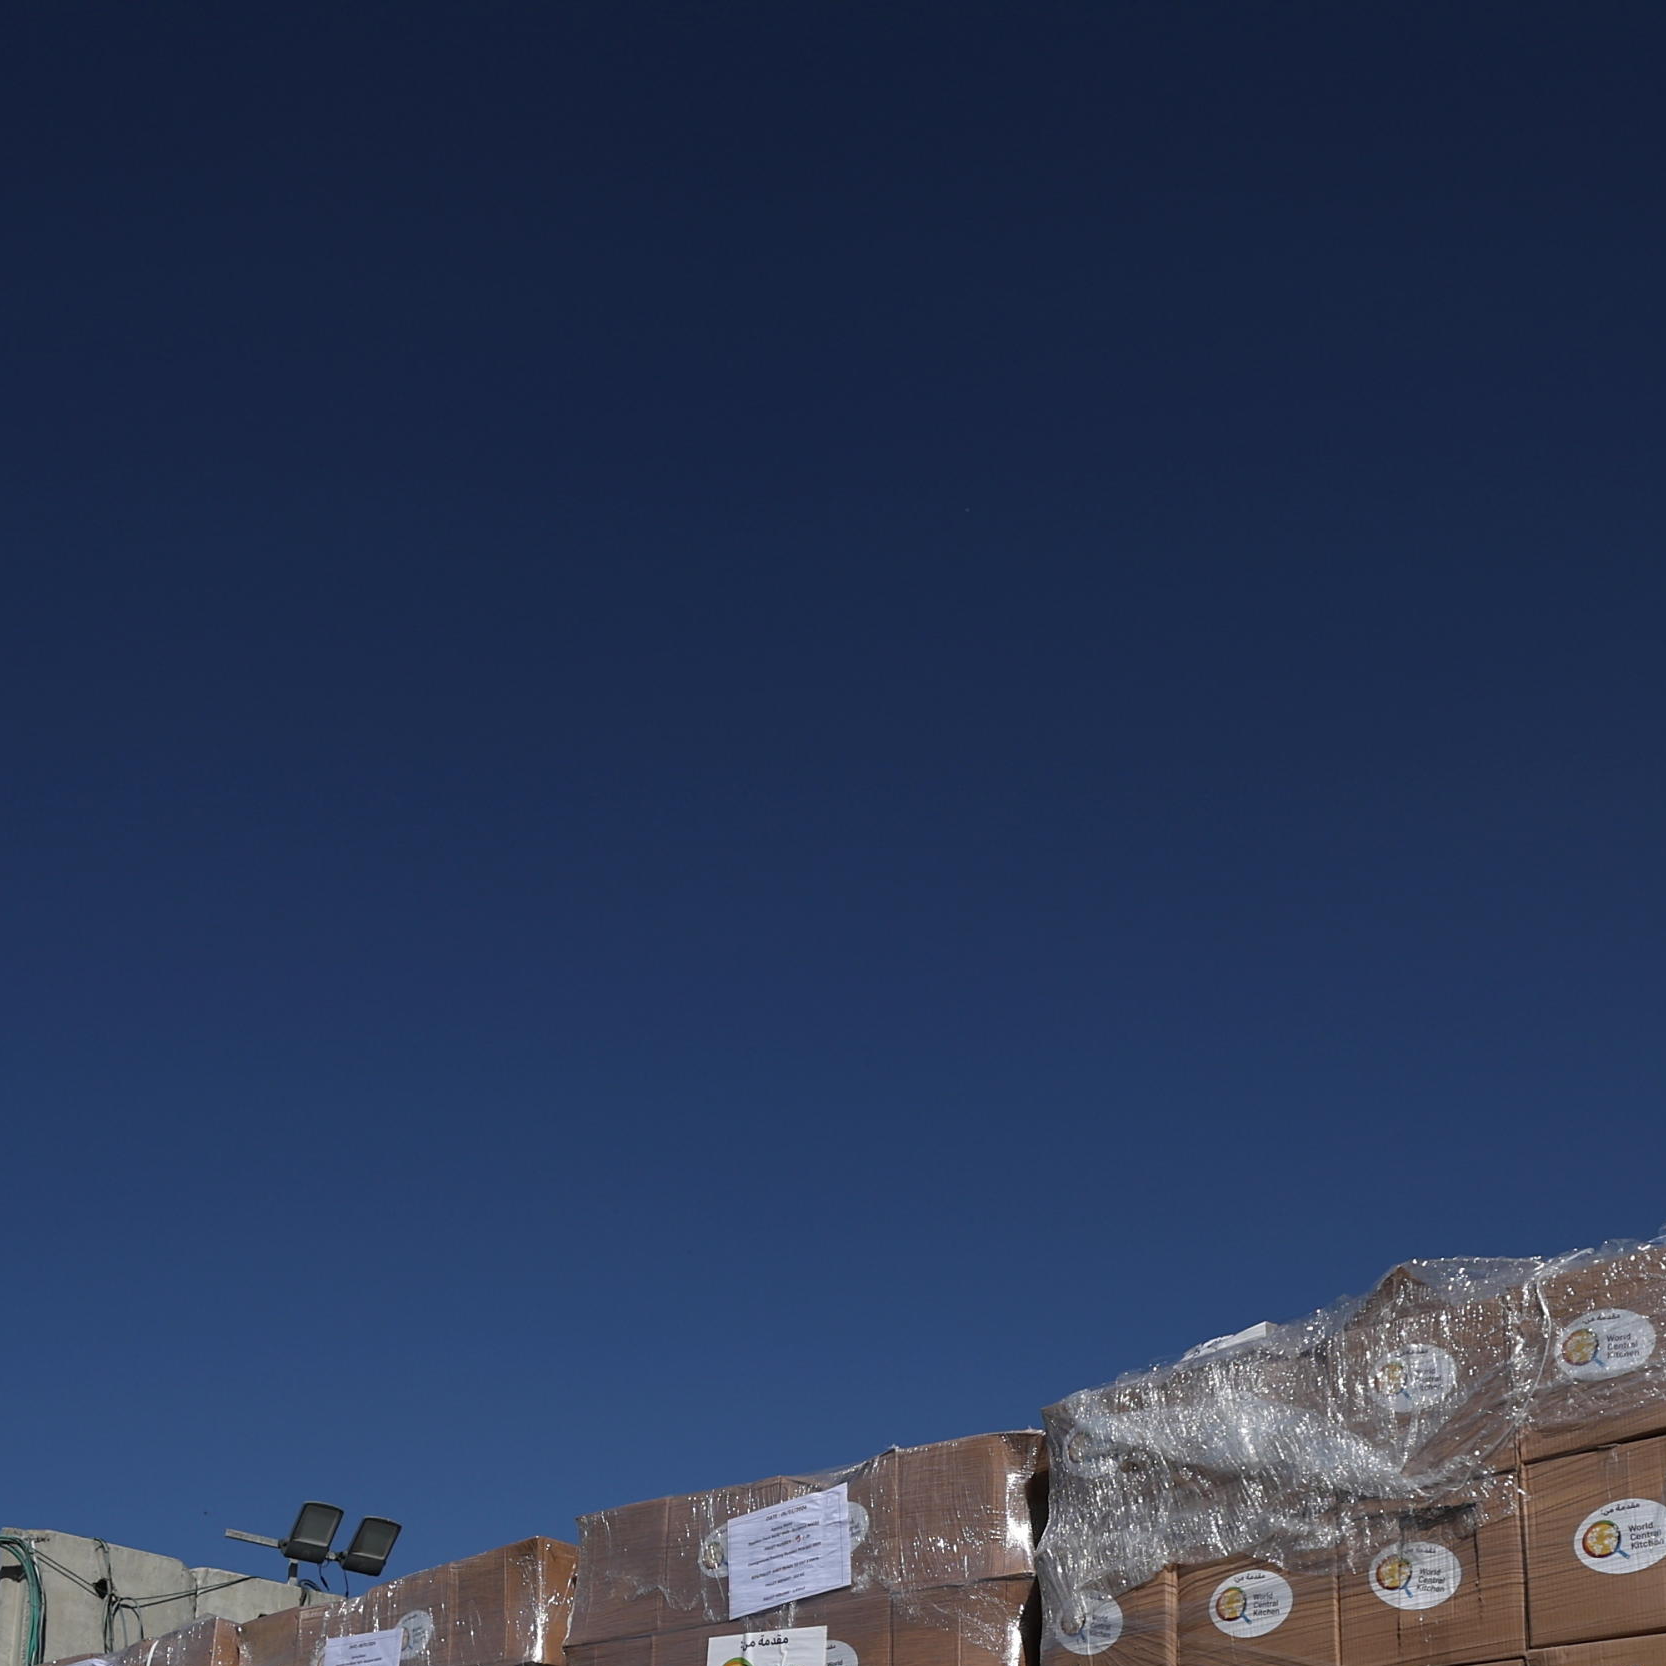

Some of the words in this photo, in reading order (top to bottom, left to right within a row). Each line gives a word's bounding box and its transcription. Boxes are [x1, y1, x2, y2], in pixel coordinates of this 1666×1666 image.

[1628, 1522, 1654, 1532] World
[1630, 1528, 1662, 1541] Central
[1630, 1538, 1665, 1550] Kitchen
[758, 1635, 789, 1647] مقدمة
